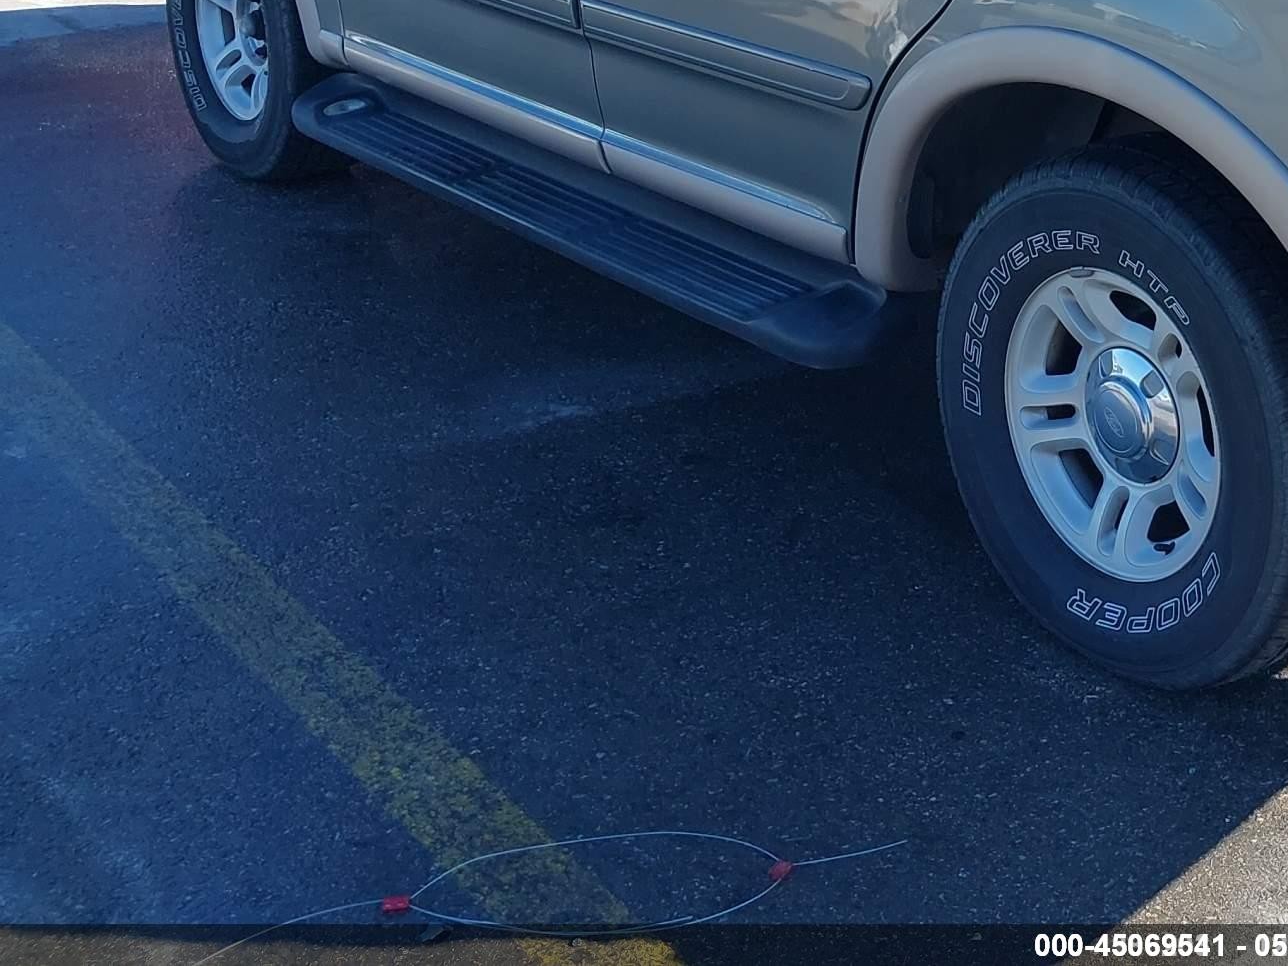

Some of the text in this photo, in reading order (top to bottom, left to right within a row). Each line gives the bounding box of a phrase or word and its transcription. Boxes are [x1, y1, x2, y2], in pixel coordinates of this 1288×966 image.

[962, 229, 1191, 416] DISCOVERER HTP
[1066, 551, 1221, 633] COOPER
